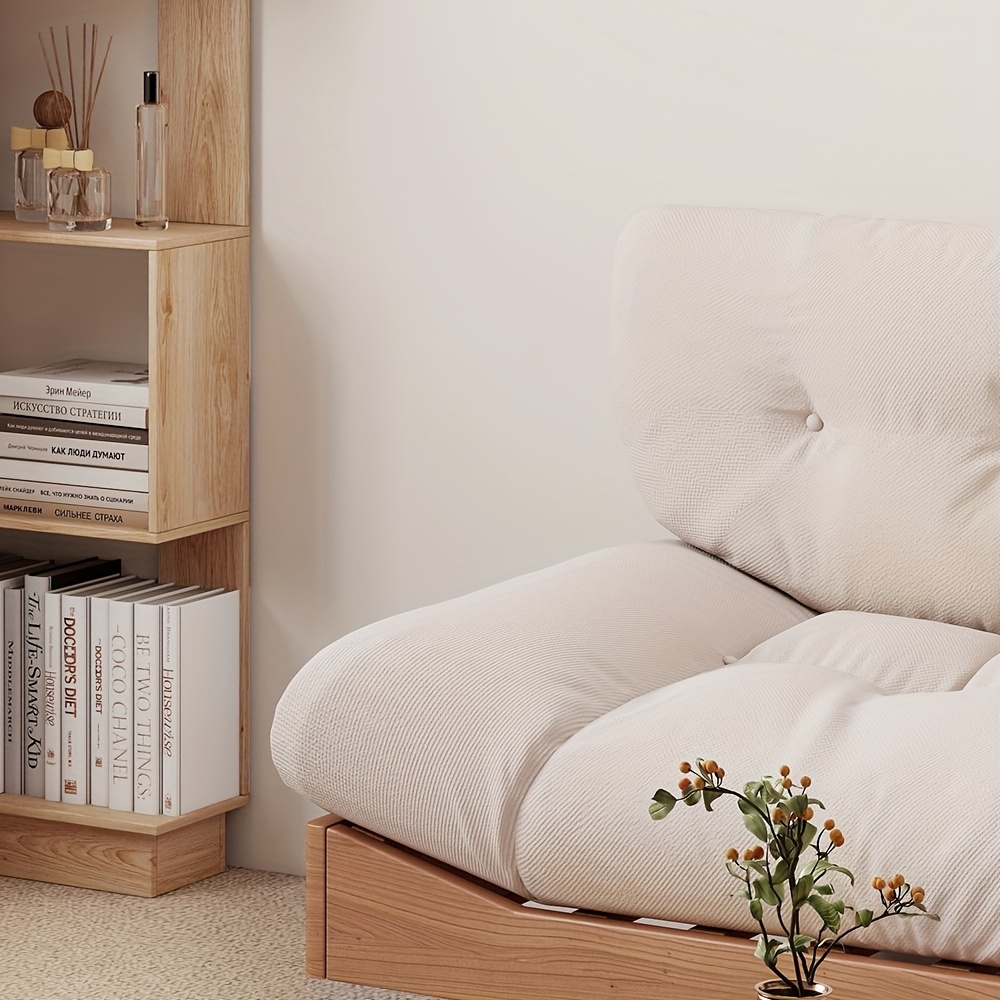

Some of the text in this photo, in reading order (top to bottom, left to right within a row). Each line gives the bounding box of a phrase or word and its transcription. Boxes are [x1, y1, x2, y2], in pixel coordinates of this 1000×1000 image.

[45, 385, 92, 399] Эрин Мейер
[12, 400, 122, 421] ИСКУССТВО СТРАТЕГИИ
[51, 446, 126, 461] КАК ЛЮДИ ДУМАЮТ
[54, 508, 123, 523] СИЛЬНЕЕ СТРАХА
[64, 687, 77, 718] DIET
[95, 693, 103, 715] DIET
[163, 668, 174, 758] Housewise
[136, 634, 152, 800] BE TWO THINGS:
[112, 701, 128, 784] CHANEL
